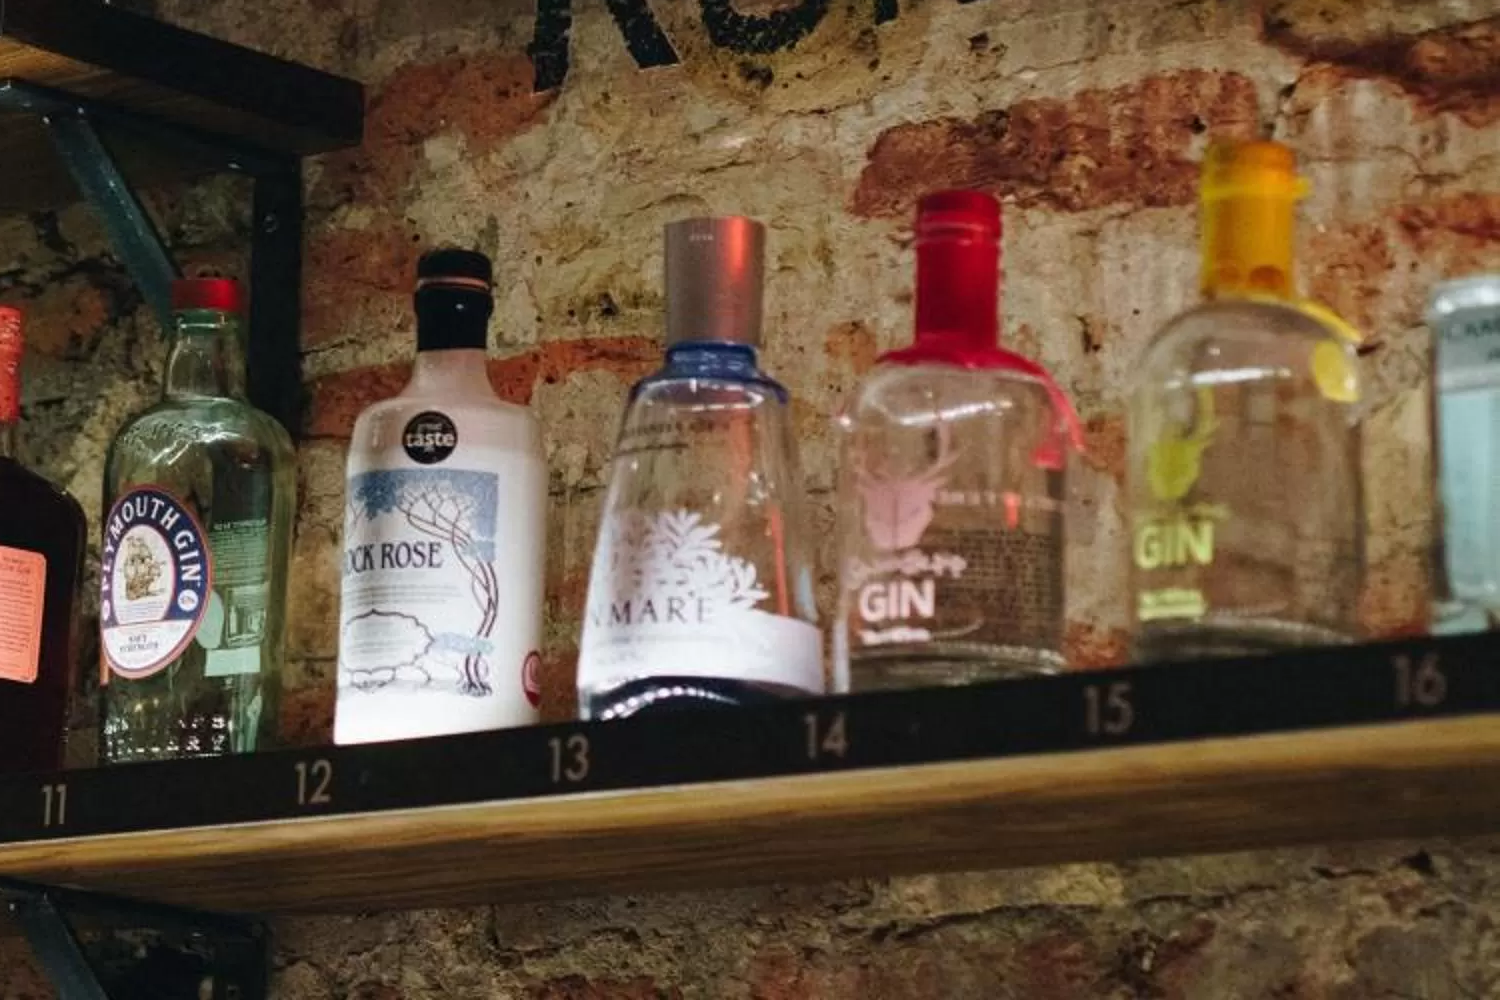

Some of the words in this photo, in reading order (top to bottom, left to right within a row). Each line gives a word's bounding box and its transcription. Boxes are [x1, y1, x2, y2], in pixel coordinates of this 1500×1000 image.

[406, 430, 456, 447] taste
[173, 528, 202, 581] GIN
[346, 543, 375, 574] OCK
[380, 540, 444, 570] ROSE
[1135, 522, 1214, 569] GIN
[860, 582, 935, 621] GIN
[1395, 655, 1446, 706] 16
[1084, 682, 1134, 735] 15
[548, 734, 589, 782] 13
[804, 712, 847, 759] 14
[42, 783, 67, 826] 11
[295, 759, 332, 805] 12
